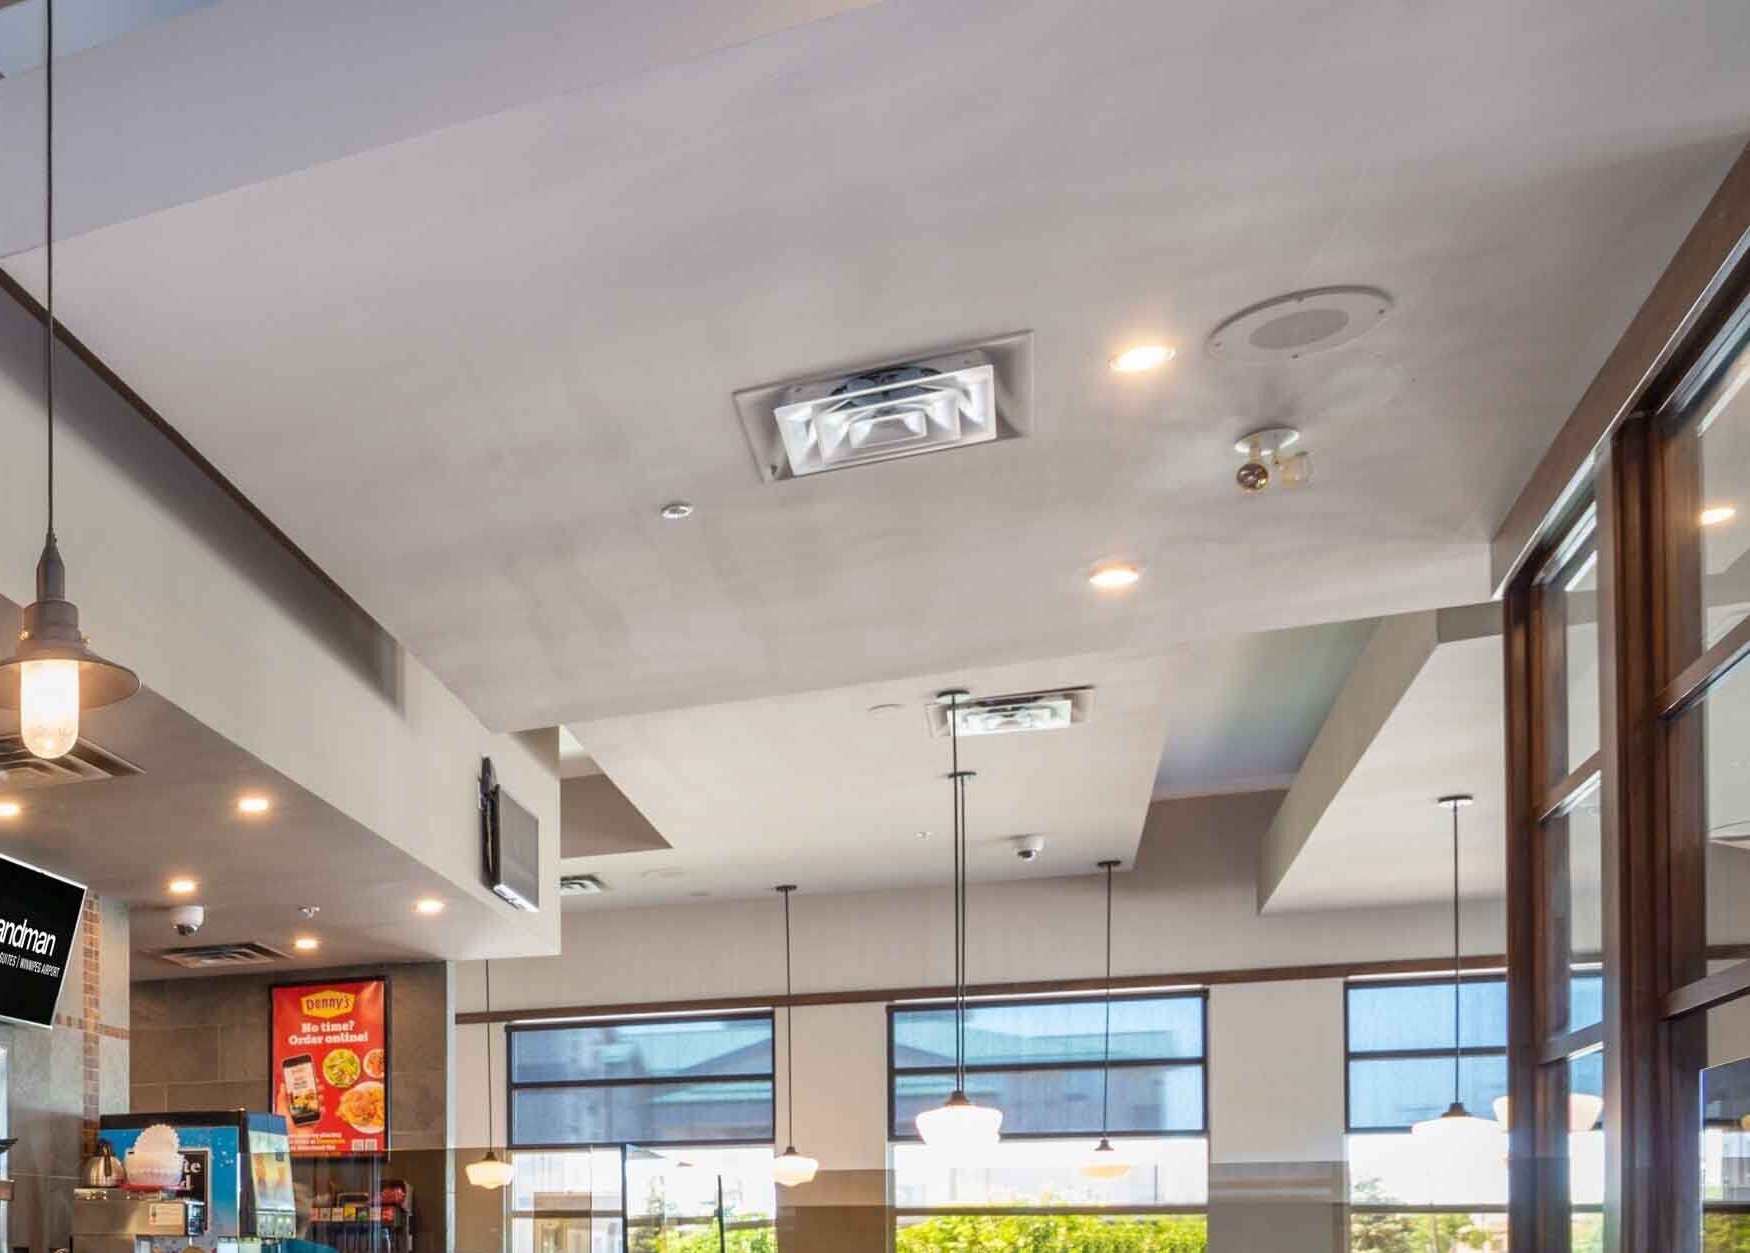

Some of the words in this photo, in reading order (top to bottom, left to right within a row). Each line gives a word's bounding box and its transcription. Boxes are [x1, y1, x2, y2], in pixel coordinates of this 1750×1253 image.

[40, 964, 61, 978] AIRPORT
[306, 995, 351, 1012] Denny's
[301, 1022, 319, 1033] No
[321, 1019, 355, 1032] time?
[288, 1034, 324, 1046] Order
